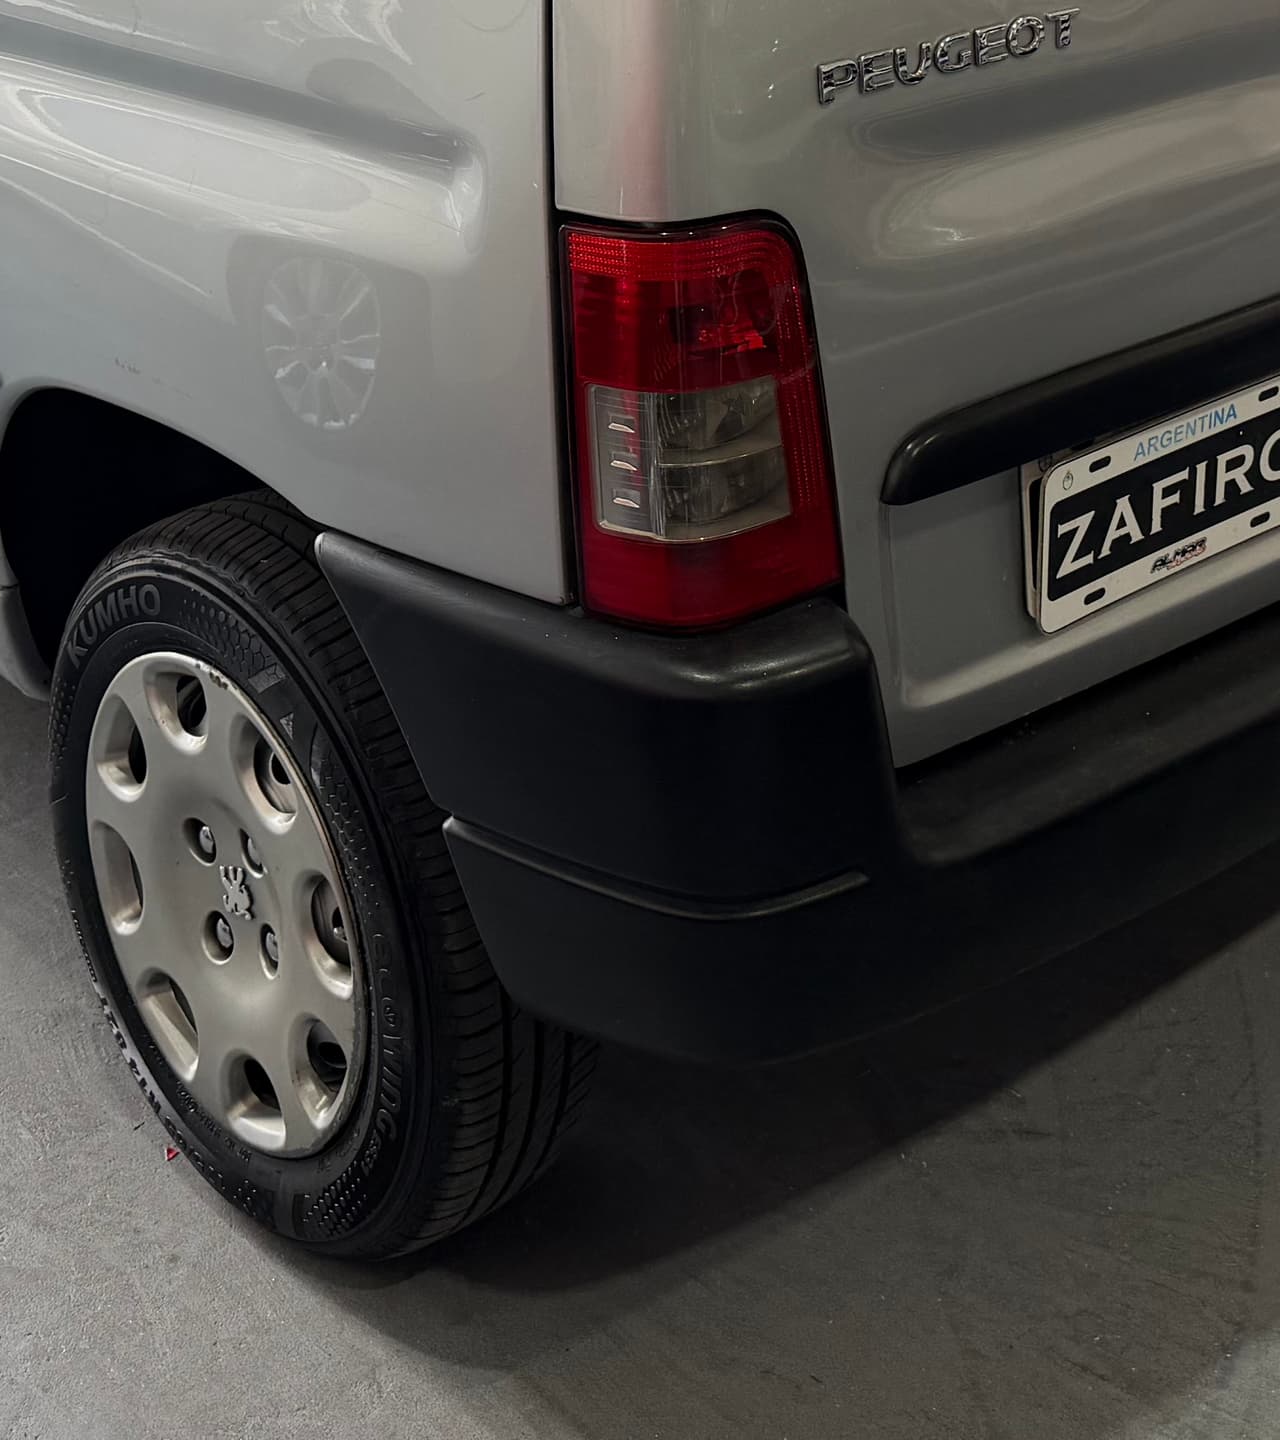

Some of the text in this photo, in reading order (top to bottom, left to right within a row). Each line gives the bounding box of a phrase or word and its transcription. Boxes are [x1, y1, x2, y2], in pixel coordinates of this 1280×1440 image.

[818, 7, 1081, 104] PEUGEOT
[1133, 403, 1238, 462] ARGENTINA
[64, 583, 161, 670] KUMHO
